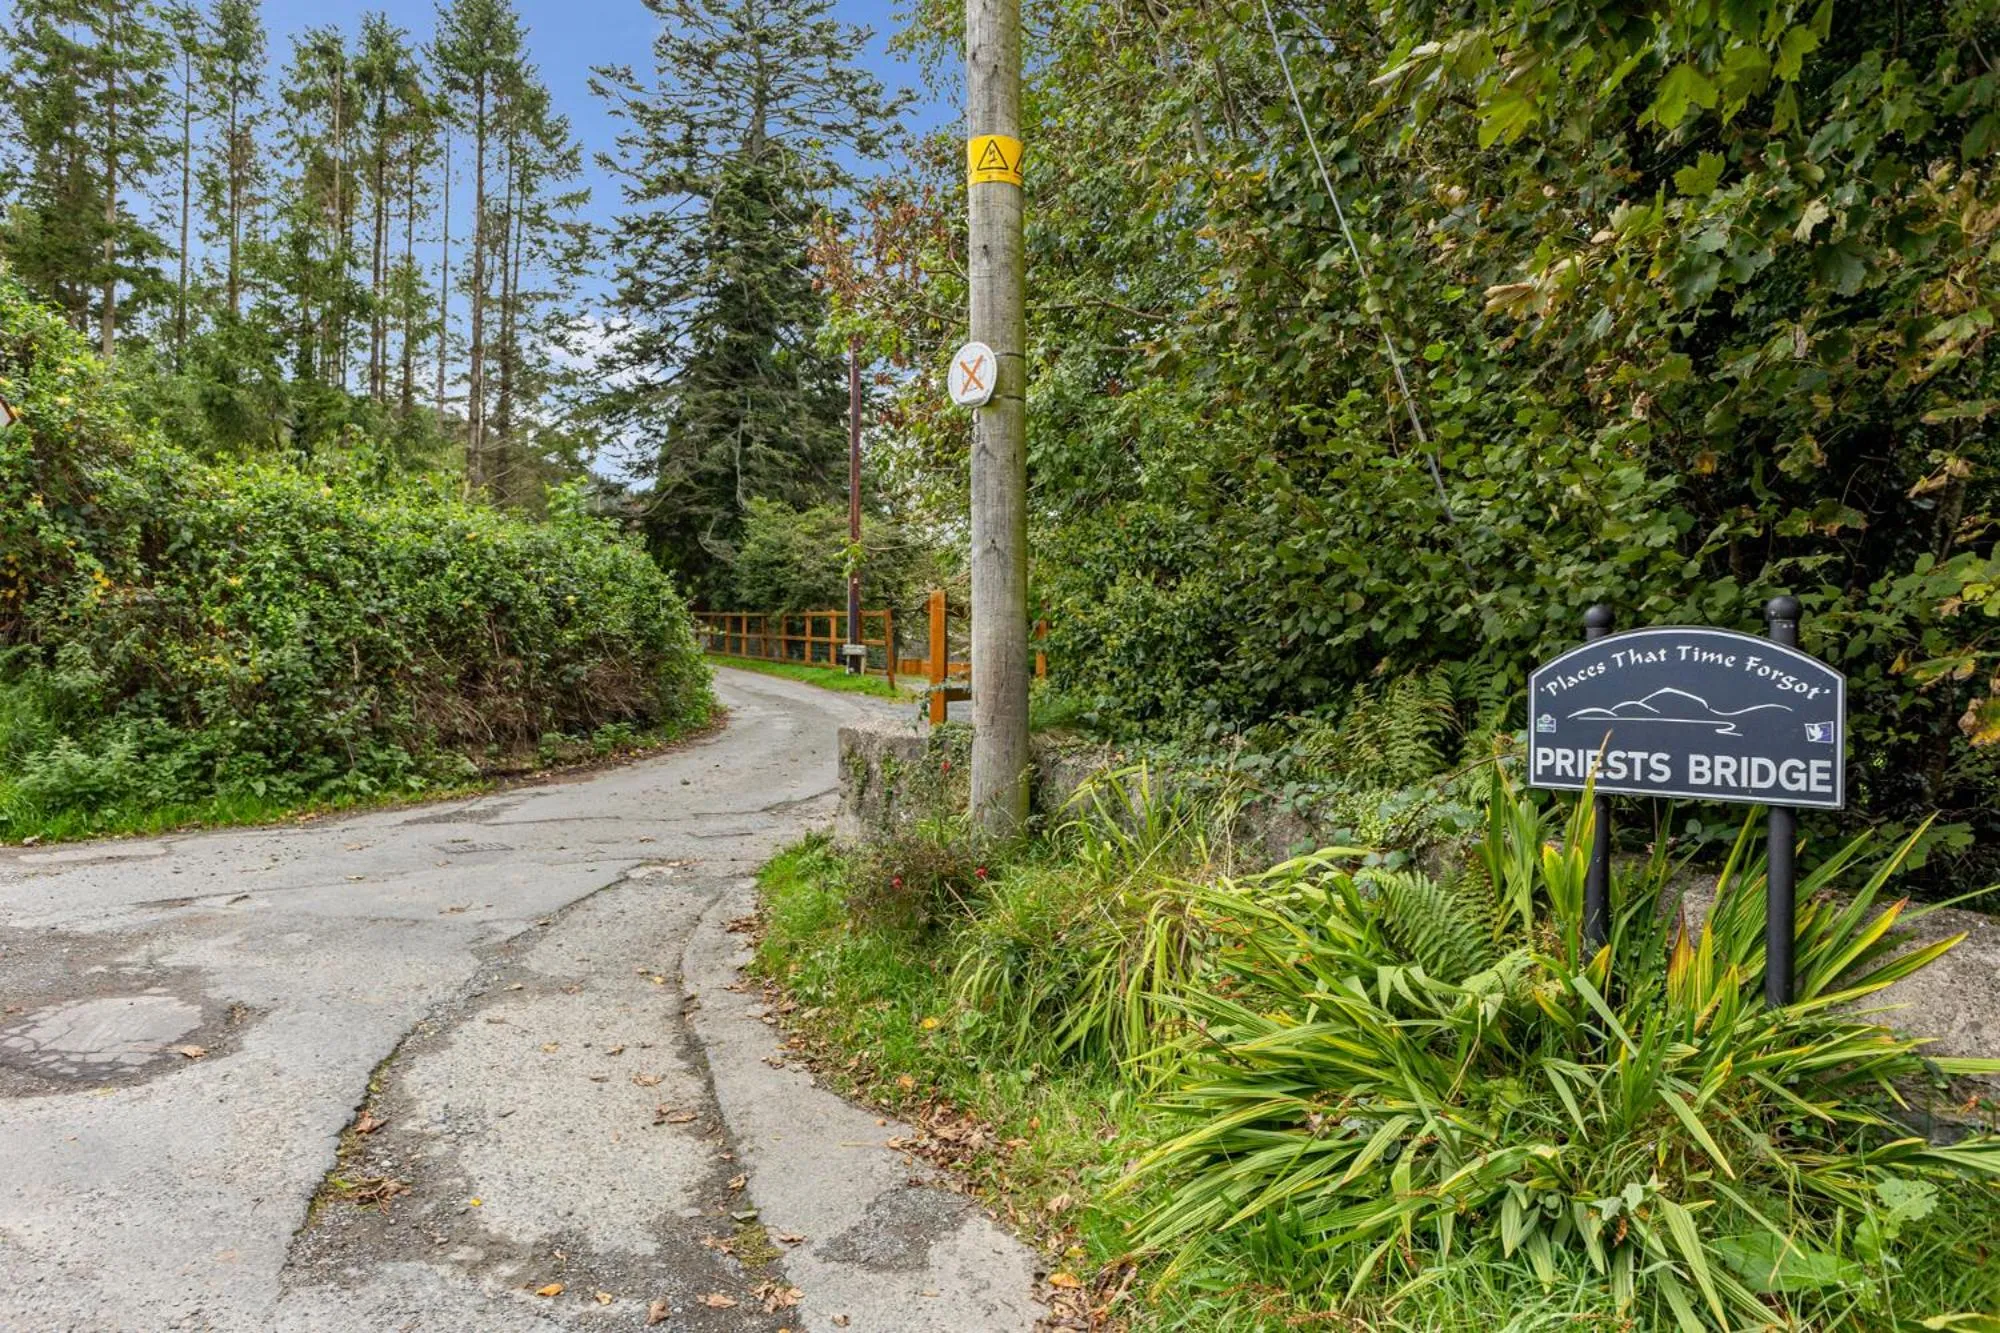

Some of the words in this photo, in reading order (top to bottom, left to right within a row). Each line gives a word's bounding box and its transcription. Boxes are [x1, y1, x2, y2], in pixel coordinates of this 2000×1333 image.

[1611, 648, 1667, 669] That
[1676, 645, 1736, 668] Time
[1536, 747, 1672, 783] PRIESTS
[1688, 753, 1833, 793] BRIDGE
